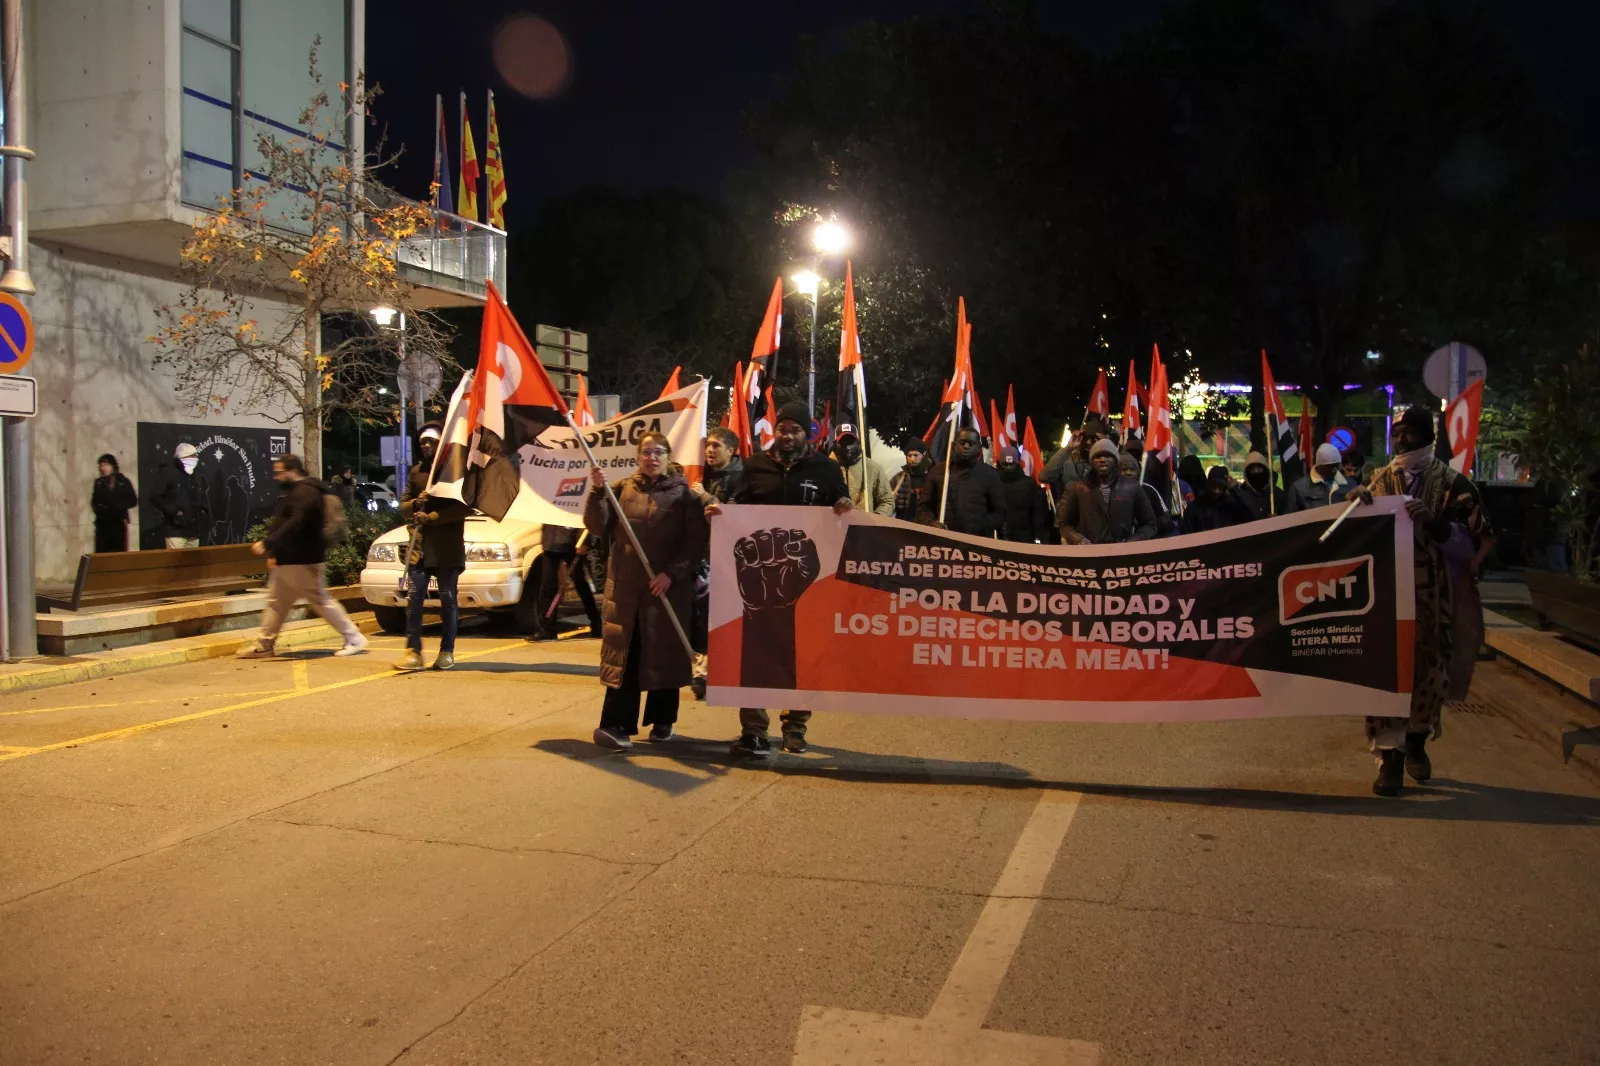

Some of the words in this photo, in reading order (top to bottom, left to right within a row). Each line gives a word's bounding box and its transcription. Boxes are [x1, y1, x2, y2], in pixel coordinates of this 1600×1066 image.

[214, 434, 240, 451] Binéfar
[270, 439, 286, 454] bnf
[529, 454, 565, 469] lucha
[567, 460, 588, 472] por
[594, 458, 608, 469] us
[562, 481, 584, 493] CNT
[899, 545, 964, 562] ¡BASTA
[969, 551, 993, 564] DE
[997, 559, 1098, 579] JORNADAS
[1101, 559, 1206, 578] ABUSIVAS,
[845, 560, 905, 577] BASTA
[909, 563, 934, 578] DE
[938, 564, 1036, 584] DESPIDOS,
[1041, 574, 1102, 590] BASTA
[1106, 578, 1131, 591] DE
[1135, 562, 1263, 586] ACCIDENTES!
[1295, 575, 1357, 604] CNT
[889, 587, 962, 614] ¡POR
[971, 590, 1008, 613] LA
[1016, 592, 1170, 616] DIGNIDAD
[1178, 598, 1196, 619] y
[834, 612, 889, 636] LOS
[898, 615, 1063, 642] DERECHOS
[1072, 616, 1255, 643] LABORALES
[1291, 626, 1325, 637] Sección
[1327, 624, 1364, 634] Sindical
[1291, 636, 1330, 646] LITERA
[1331, 634, 1362, 644] MEAT
[912, 643, 952, 665] EN
[962, 645, 1067, 670] LITERA
[1076, 648, 1170, 670] MEAT!
[1291, 647, 1326, 657] BINÉFAR
[1327, 646, 1363, 657] (Huesca)
